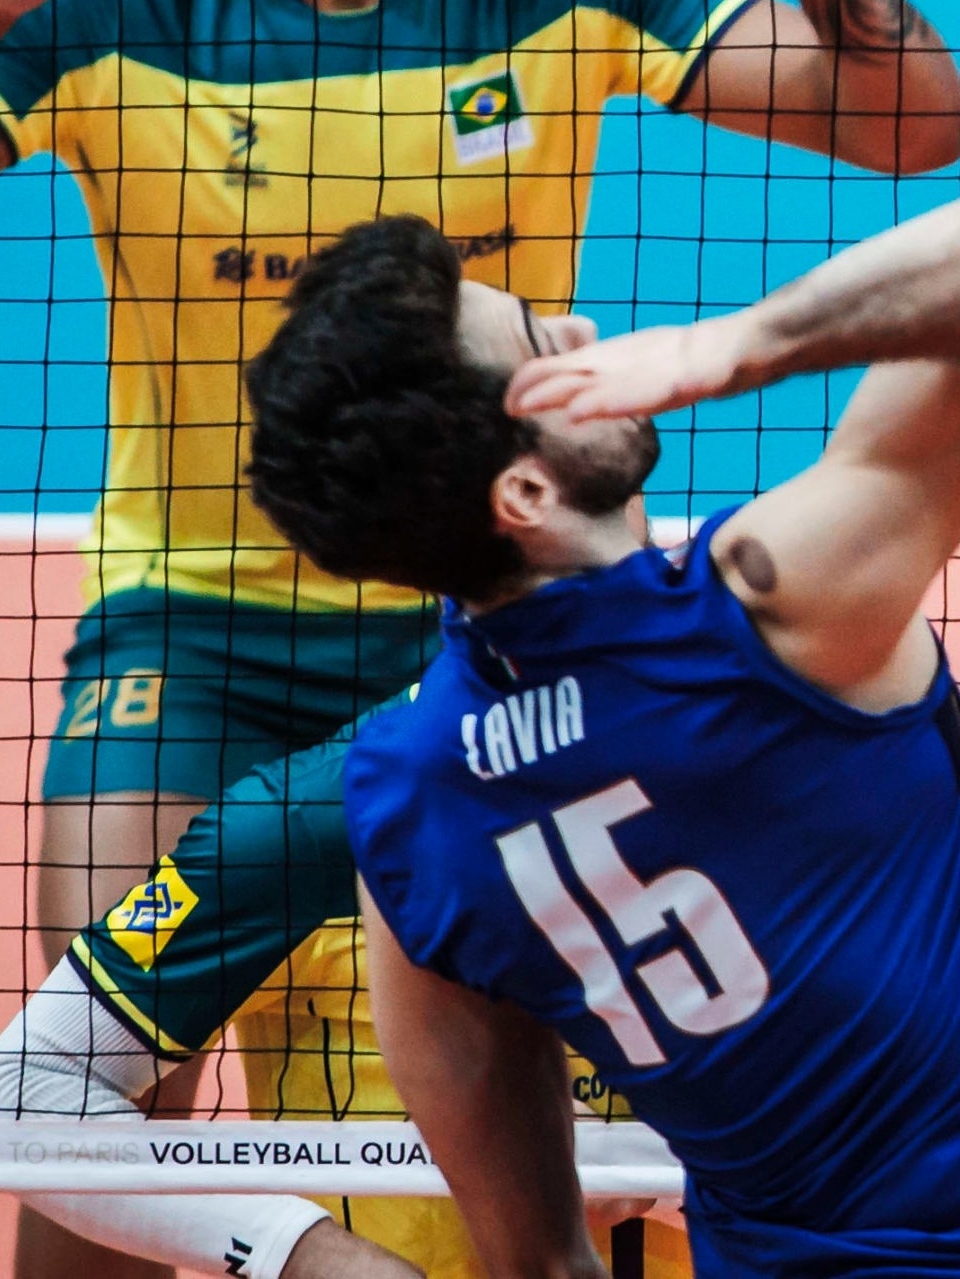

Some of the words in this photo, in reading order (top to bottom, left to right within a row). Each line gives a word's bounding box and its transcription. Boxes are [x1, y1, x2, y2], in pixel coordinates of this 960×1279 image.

[65, 667, 165, 743] 28
[461, 675, 585, 781] LAVIA
[495, 776, 770, 1067] 15
[8, 1141, 47, 1163] TO
[58, 1142, 139, 1163] PARIS
[149, 1142, 351, 1165] VOLLEYBALL
[361, 1142, 436, 1167] QUA
